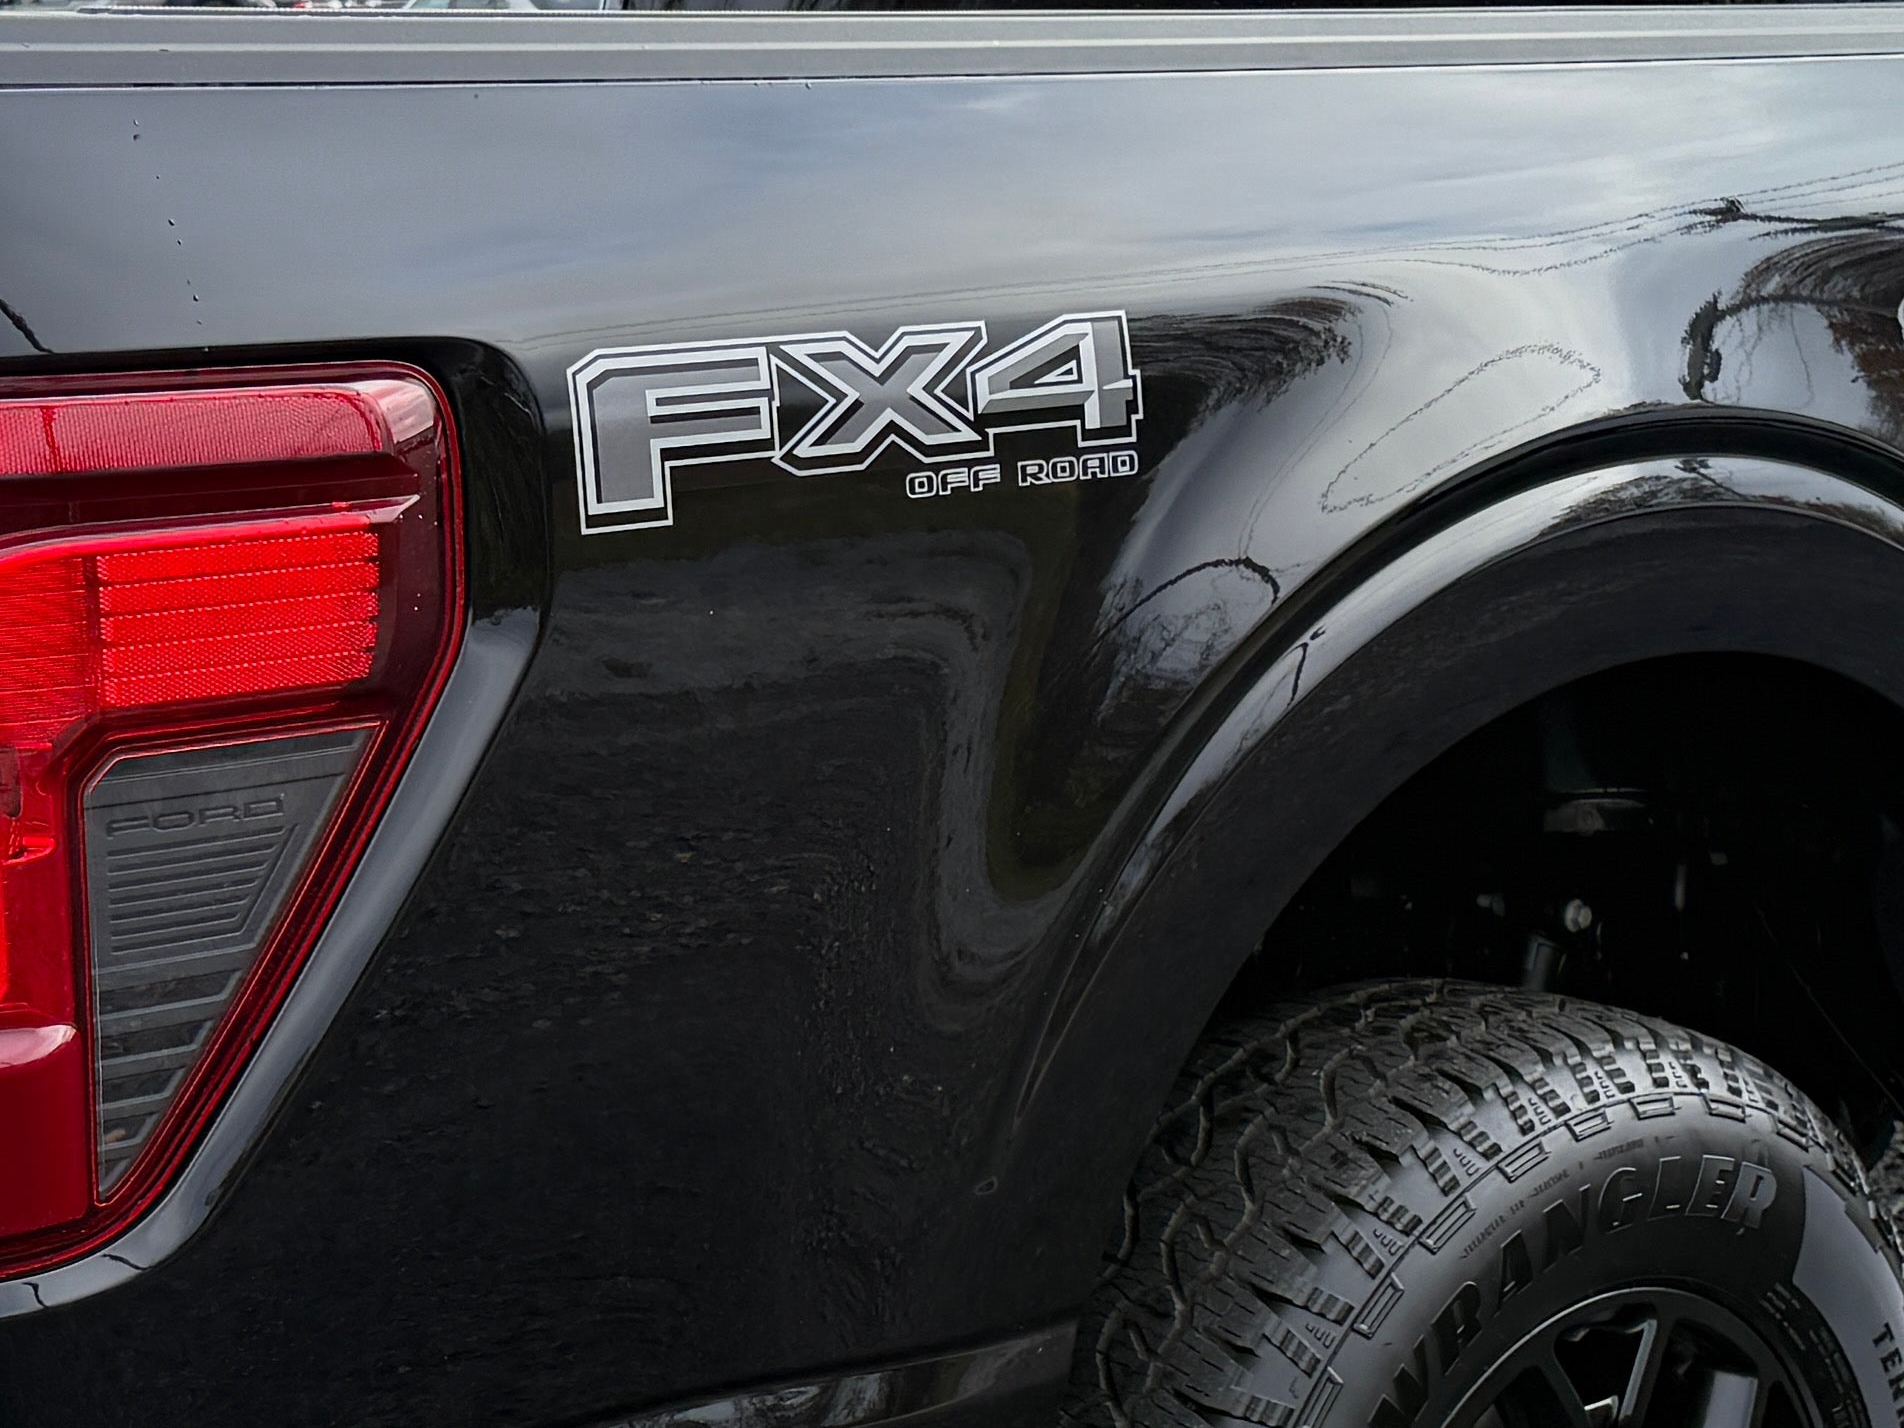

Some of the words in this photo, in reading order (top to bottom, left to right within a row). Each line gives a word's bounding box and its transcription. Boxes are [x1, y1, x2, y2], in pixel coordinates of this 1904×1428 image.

[566, 309, 1144, 536] FX4
[905, 465, 1001, 498] OFF
[1017, 449, 1139, 486] ROAD
[105, 796, 284, 840] FORD
